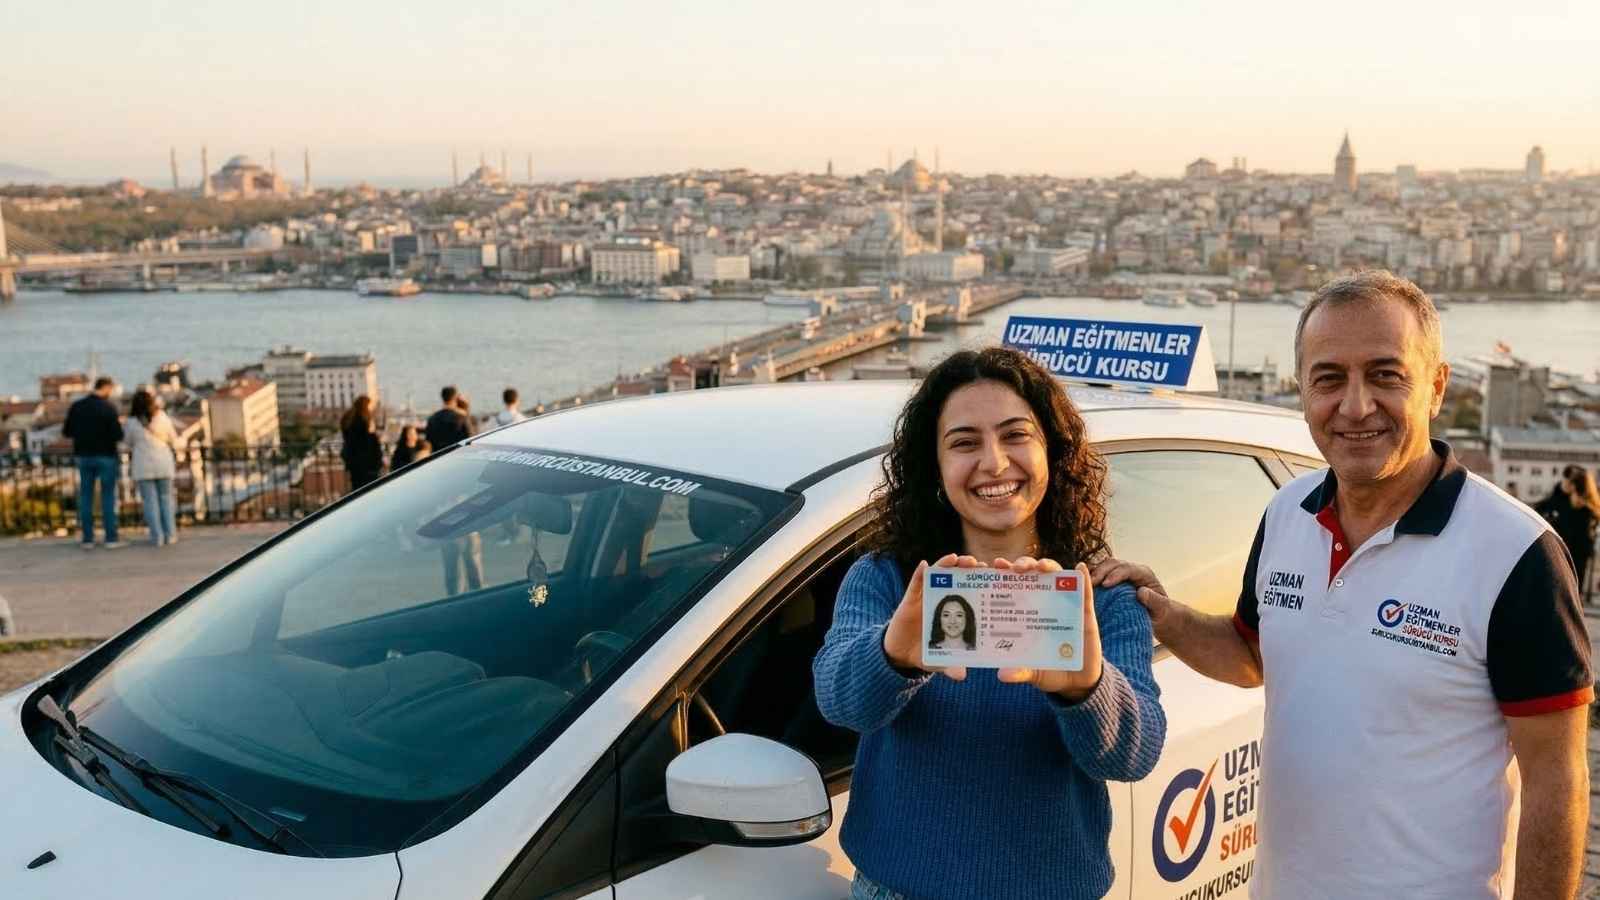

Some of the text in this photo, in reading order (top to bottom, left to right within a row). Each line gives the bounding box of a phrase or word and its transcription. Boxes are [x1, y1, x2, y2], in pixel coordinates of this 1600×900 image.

[1008, 323, 1191, 356] UZMAN EĞİTMENLER
[1095, 357, 1170, 382] KURSU
[966, 573, 1000, 582] SÜRÜCÜ
[1269, 571, 1304, 589] UZMAN
[1263, 587, 1304, 610] EĞİTMEN
[1408, 603, 1441, 619] UZMAN
[1402, 625, 1460, 648] SÜRÜCÜ KURSU
[1405, 613, 1461, 637] EĞİTMENLER
